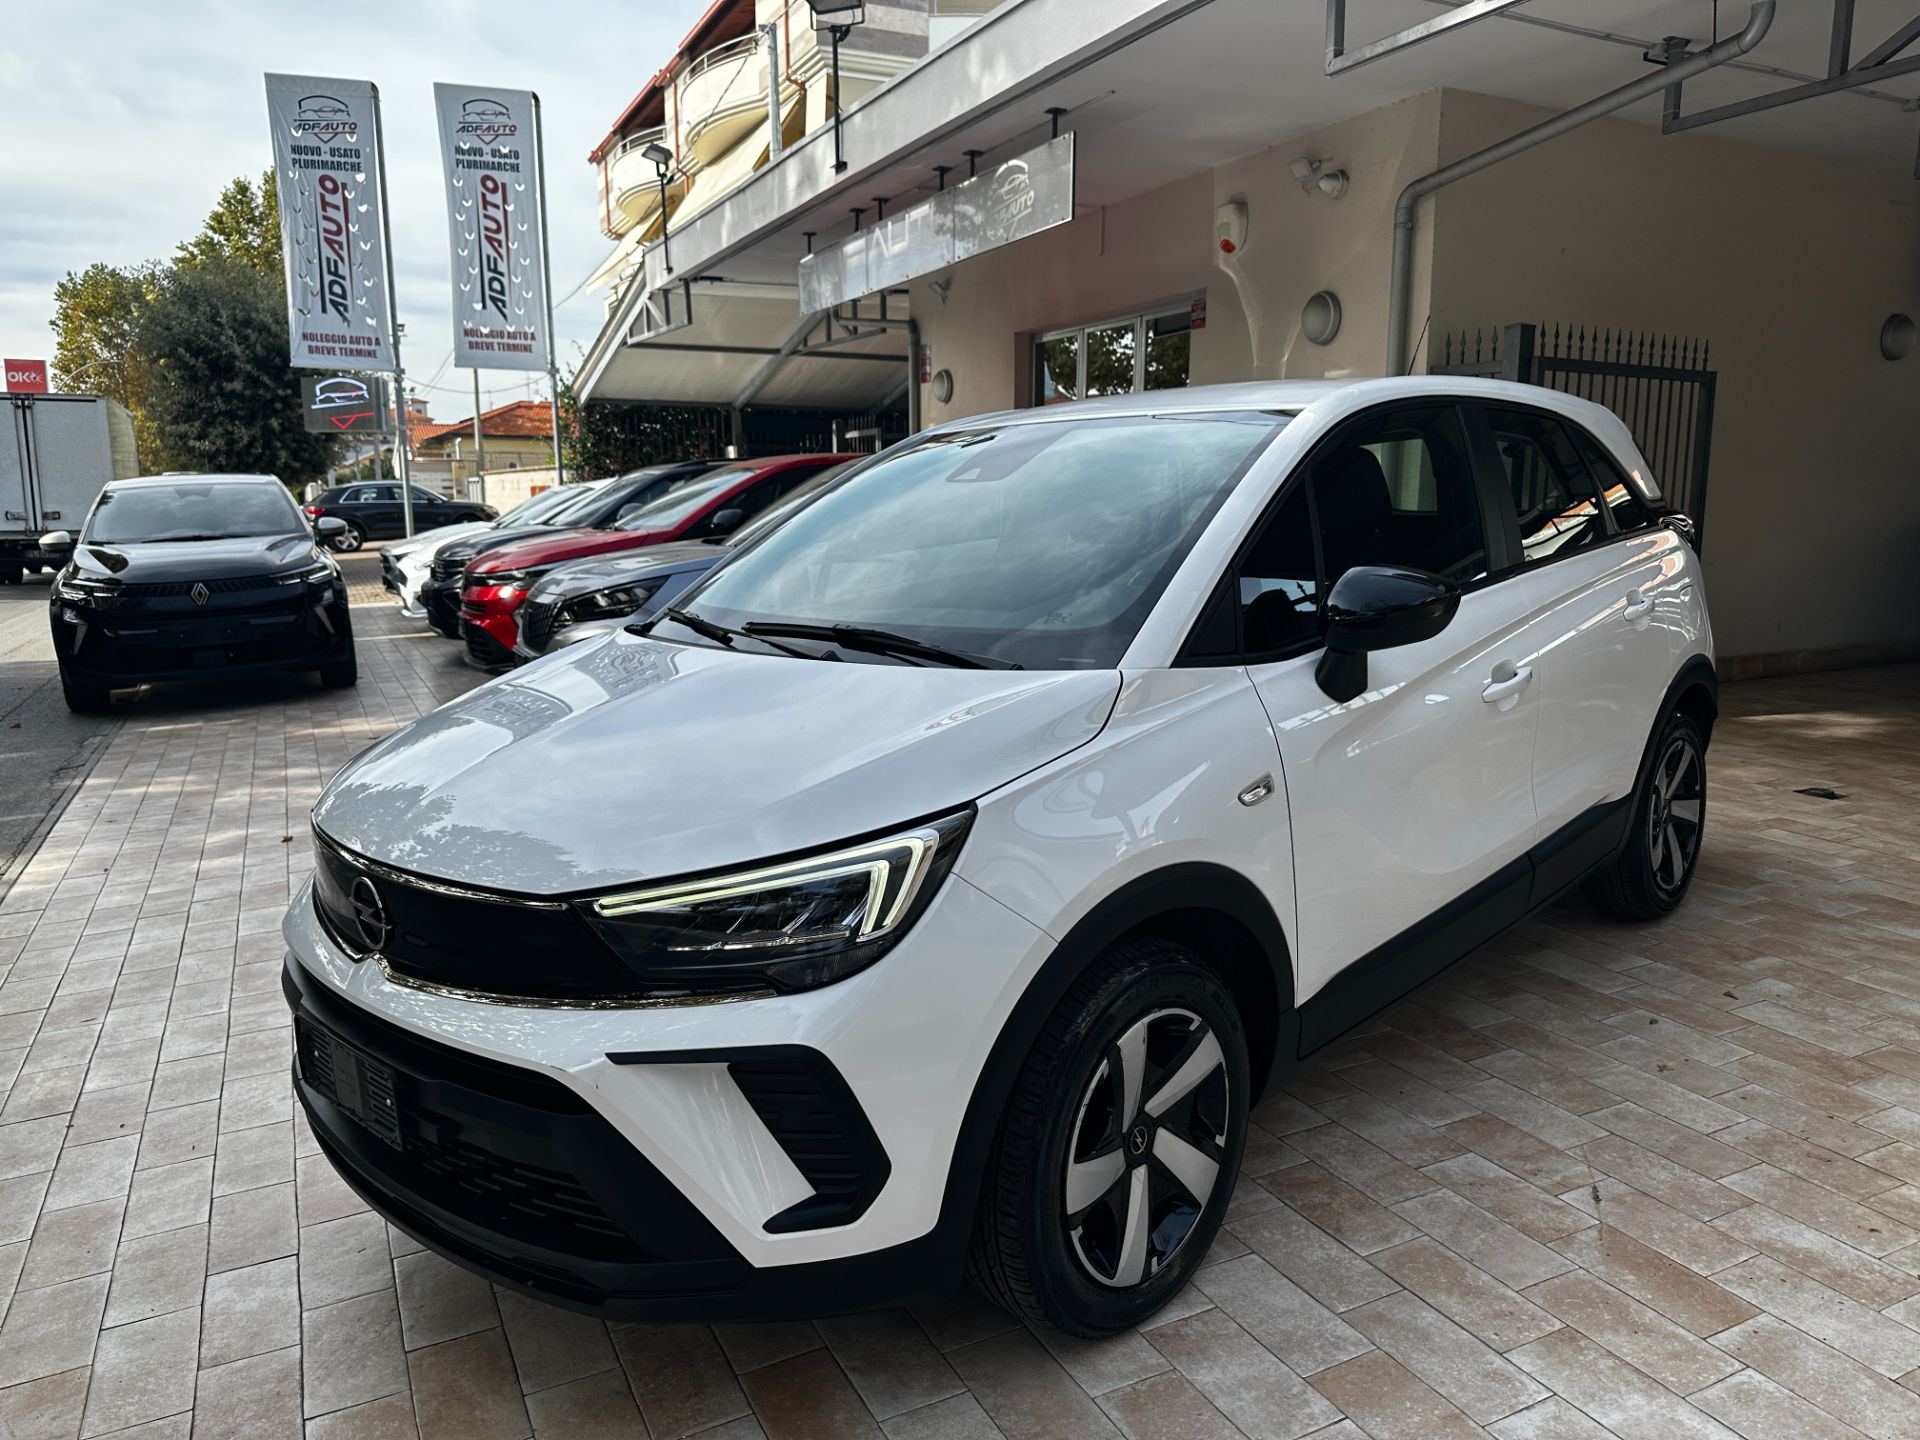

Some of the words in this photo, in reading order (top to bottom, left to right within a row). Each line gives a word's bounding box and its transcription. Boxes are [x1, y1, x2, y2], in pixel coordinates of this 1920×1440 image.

[456, 124, 517, 133] ADFAUTO
[290, 144, 321, 157] NUOVO
[329, 146, 361, 159] USATO
[292, 157, 362, 172] PLURIMARCHE
[455, 158, 521, 173] PLURIMARCHE
[318, 174, 351, 327] ADFAUTO
[480, 174, 508, 322] ADFAUTO
[302, 332, 347, 344] NOLEGGIO
[349, 336, 373, 346] AUTO
[374, 337, 381, 347] A
[506, 329, 529, 341] AUTO
[530, 330, 536, 341] A
[308, 345, 337, 356] BREVE
[338, 347, 378, 359] TERMINE
[468, 340, 496, 351] BREVE
[497, 342, 533, 353] TERMINE
